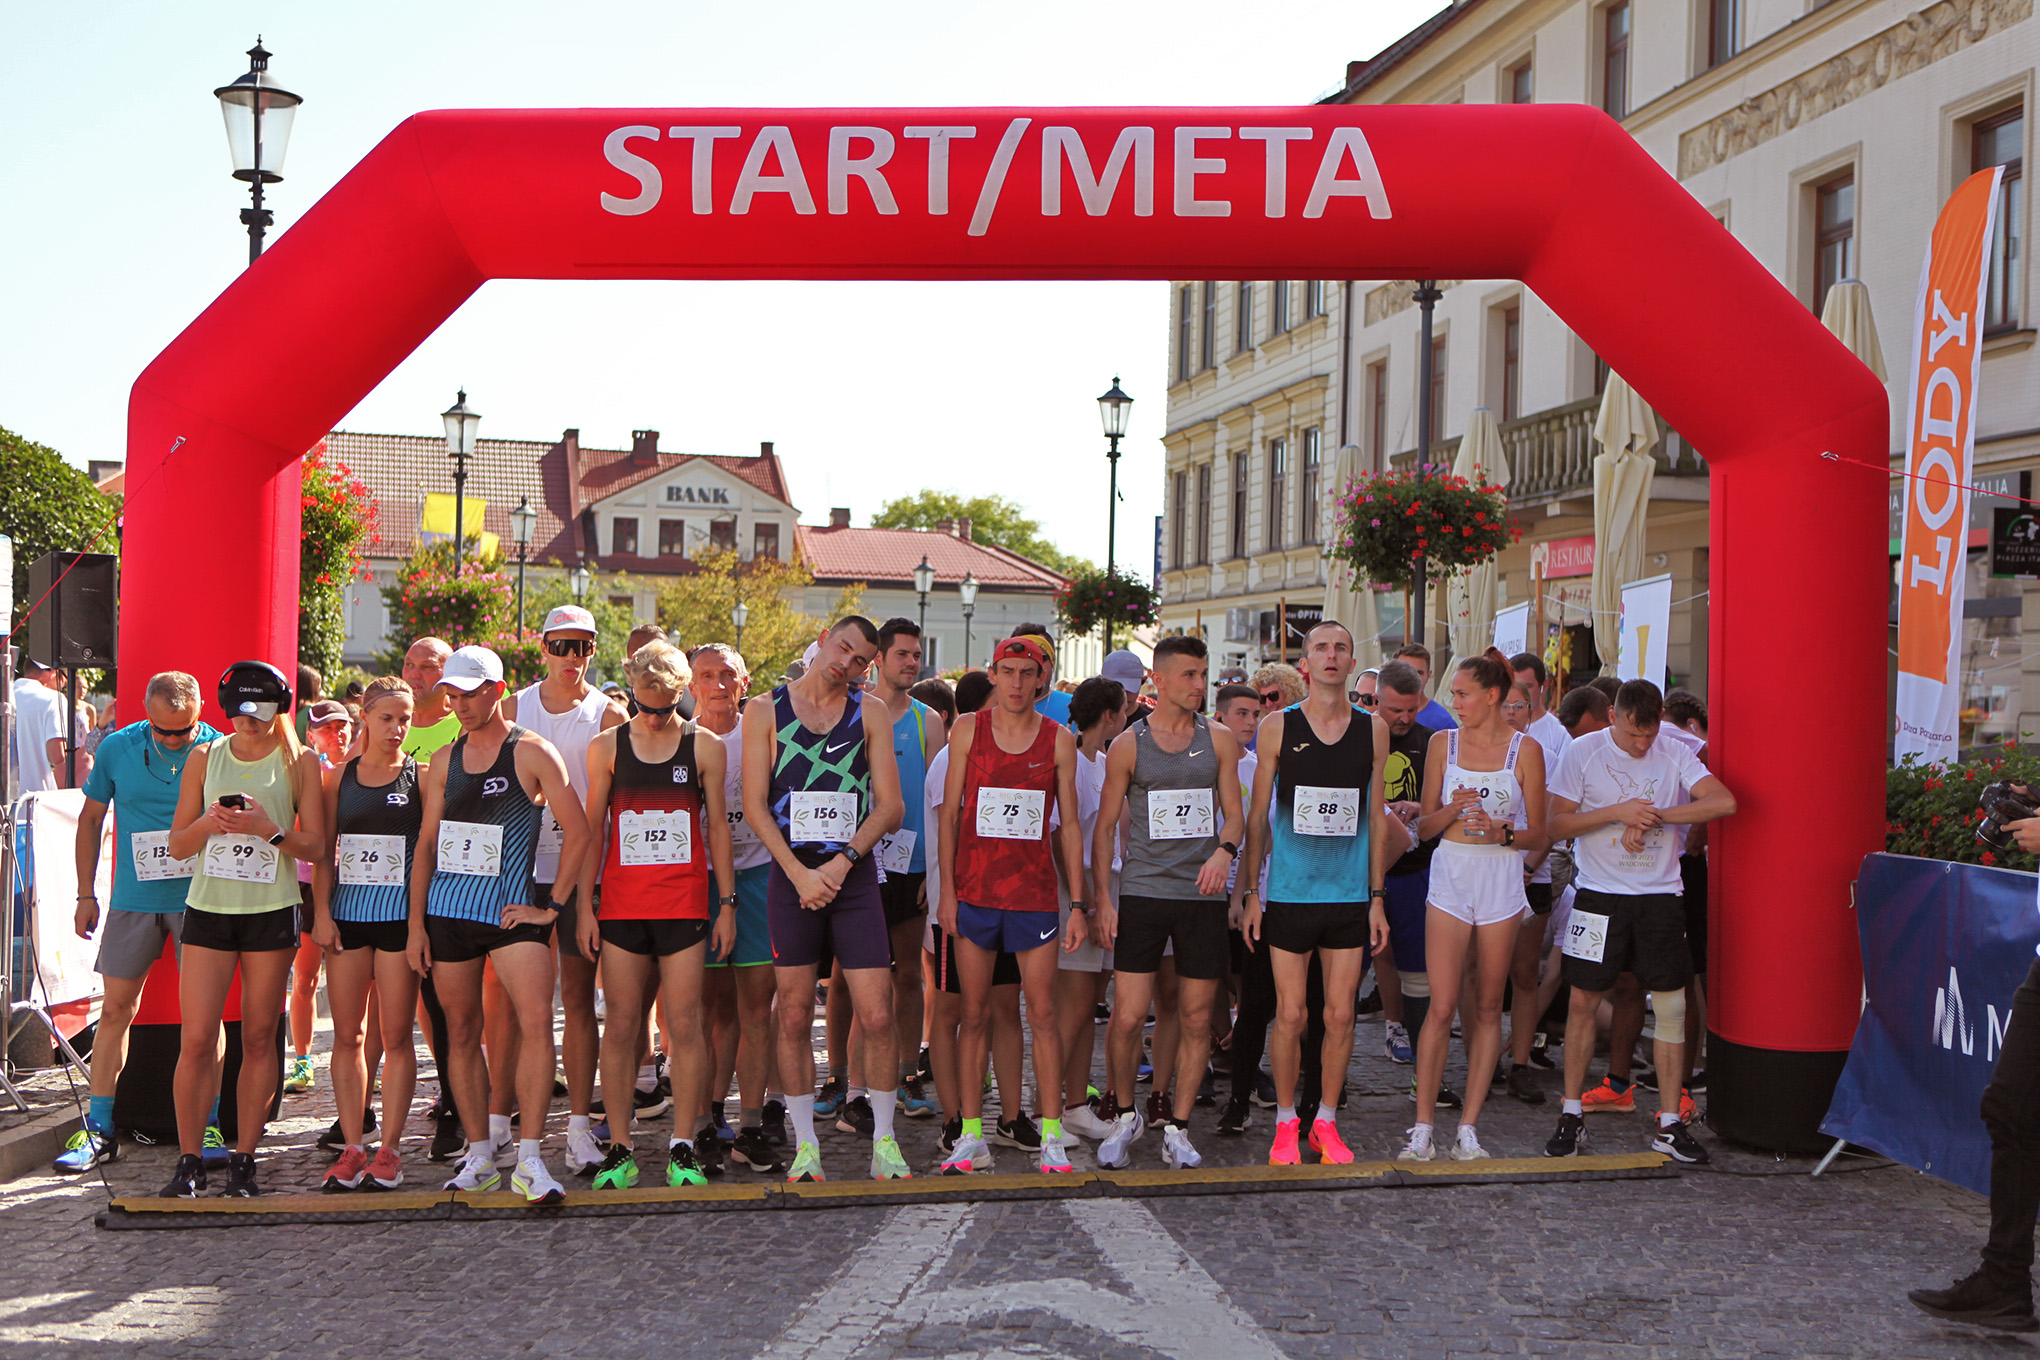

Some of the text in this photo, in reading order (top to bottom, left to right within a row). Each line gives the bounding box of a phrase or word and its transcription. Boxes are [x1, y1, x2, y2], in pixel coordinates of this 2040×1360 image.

[600, 118, 1393, 237] START/META
[1911, 289, 1967, 595] LODY
[666, 486, 729, 504] BANK
[814, 807, 838, 819] 156
[1002, 804, 1020, 816] 75
[1175, 804, 1191, 817] 27
[1318, 803, 1338, 814] 88
[644, 829, 667, 842] 152
[232, 844, 254, 858] 99
[463, 839, 472, 851] 3
[360, 850, 379, 863] 26
[1570, 925, 1586, 937] 127
